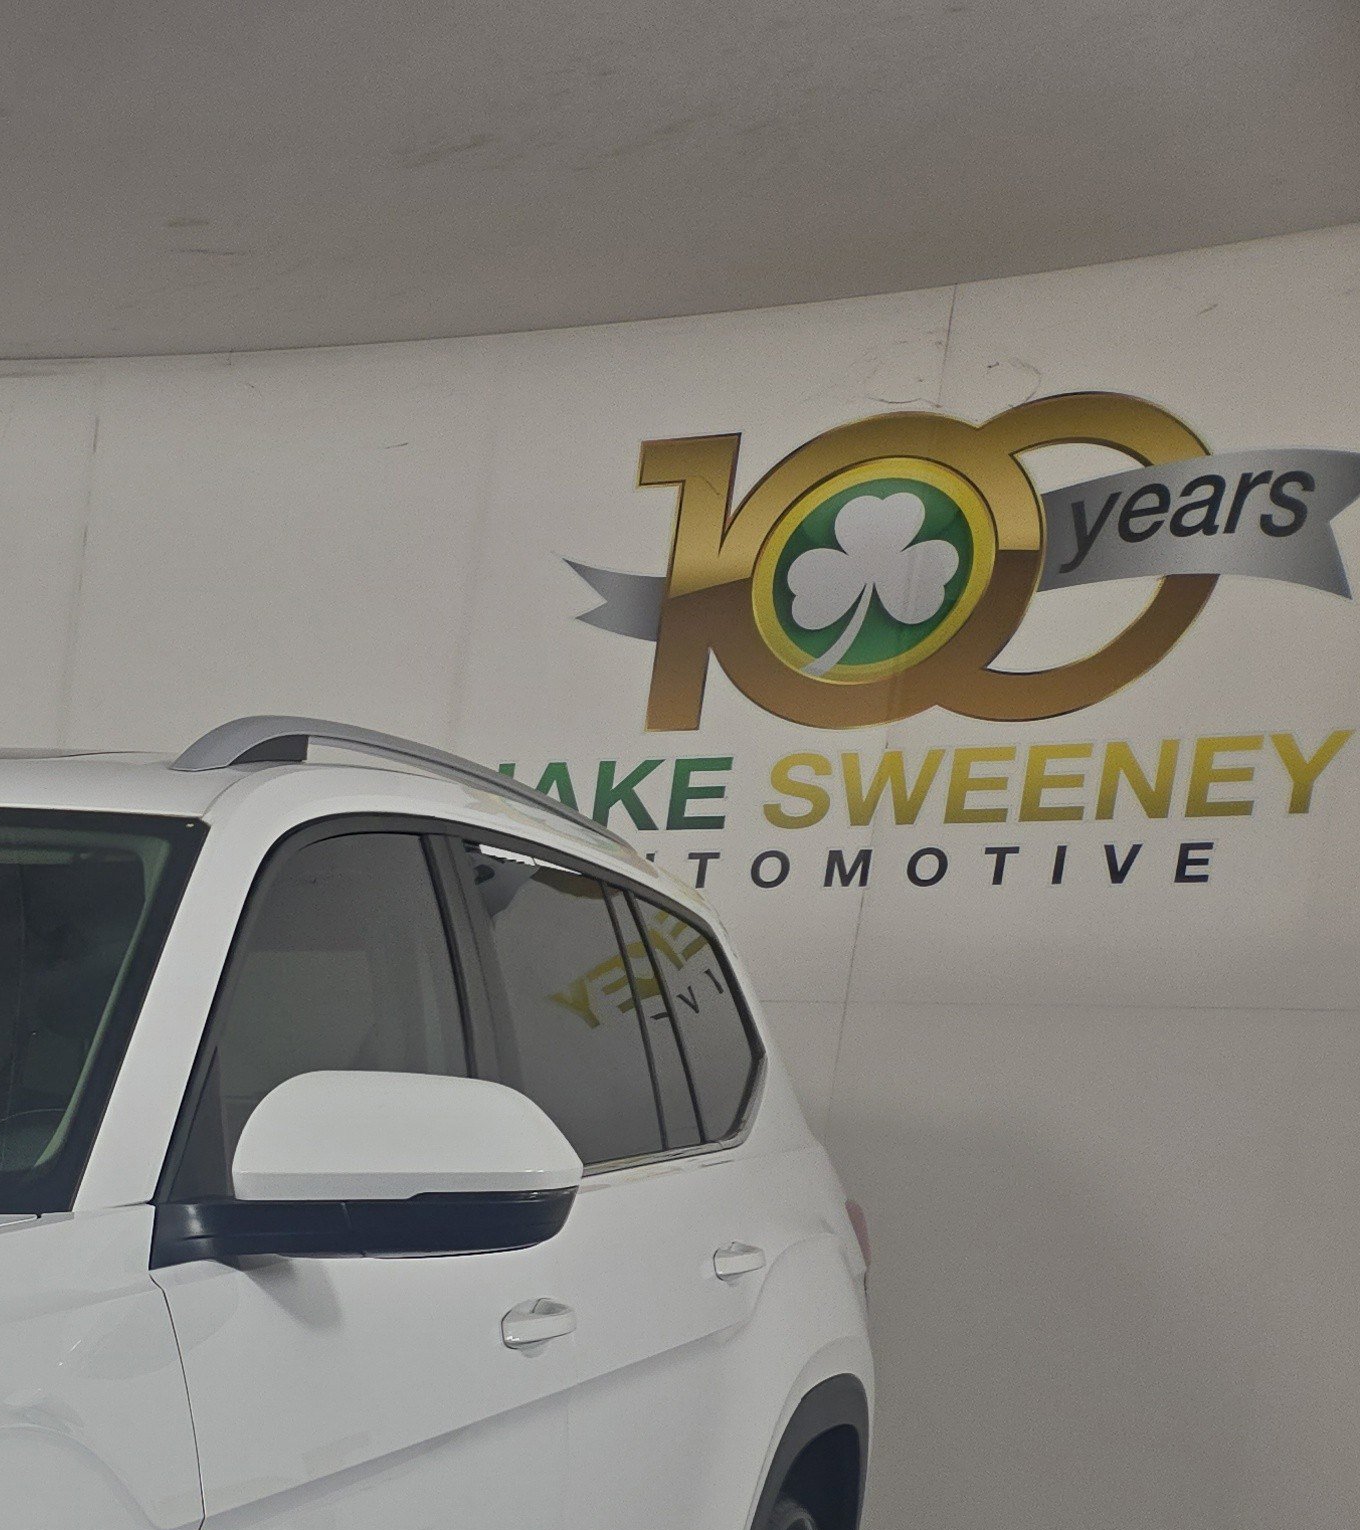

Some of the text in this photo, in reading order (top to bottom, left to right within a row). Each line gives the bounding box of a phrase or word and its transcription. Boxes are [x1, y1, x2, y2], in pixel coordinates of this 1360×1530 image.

[637, 390, 1224, 733] 100
[1060, 467, 1316, 571] years
[498, 729, 1355, 832] AKE SWEENEY
[645, 841, 1216, 890] TOMOTIVE
